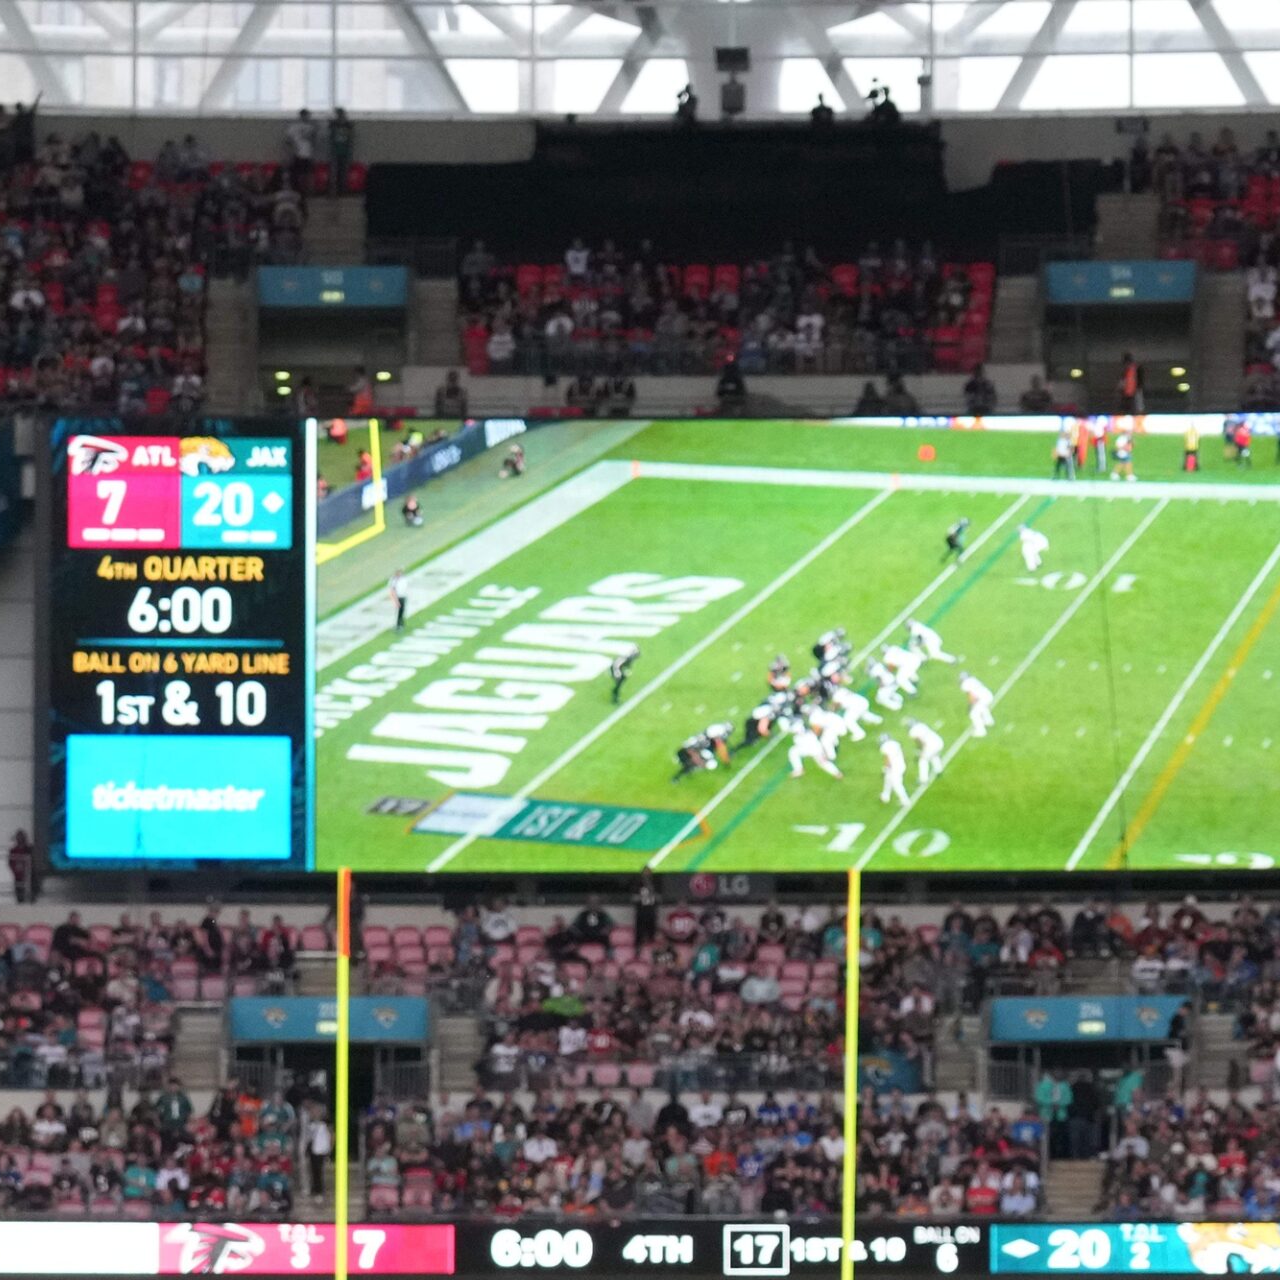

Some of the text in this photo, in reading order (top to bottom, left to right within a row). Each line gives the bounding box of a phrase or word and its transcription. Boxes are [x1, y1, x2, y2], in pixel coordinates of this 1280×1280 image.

[132, 445, 176, 467] ATL
[247, 446, 288, 467] JAX
[96, 480, 127, 525] 7
[192, 481, 254, 526] 20
[96, 555, 264, 581] 4TH QUARTER
[127, 586, 232, 633] 6:00
[72, 652, 290, 674] BALL ON 6 YARD LINE
[346, 572, 745, 788] JAGUARS
[96, 680, 267, 726] 1ST & 10
[92, 780, 265, 812] ticketmaster
[720, 876, 750, 897] LG
[353, 1230, 387, 1269] 7
[490, 1229, 594, 1268] 6:00
[622, 1234, 694, 1264] 4TH
[732, 1233, 781, 1265] 17
[789, 1237, 845, 1263] 1ST
[869, 1237, 907, 1263] 10
[935, 1243, 960, 1274] 6
[1047, 1228, 1112, 1269] 20
[1129, 1243, 1151, 1270] 2
